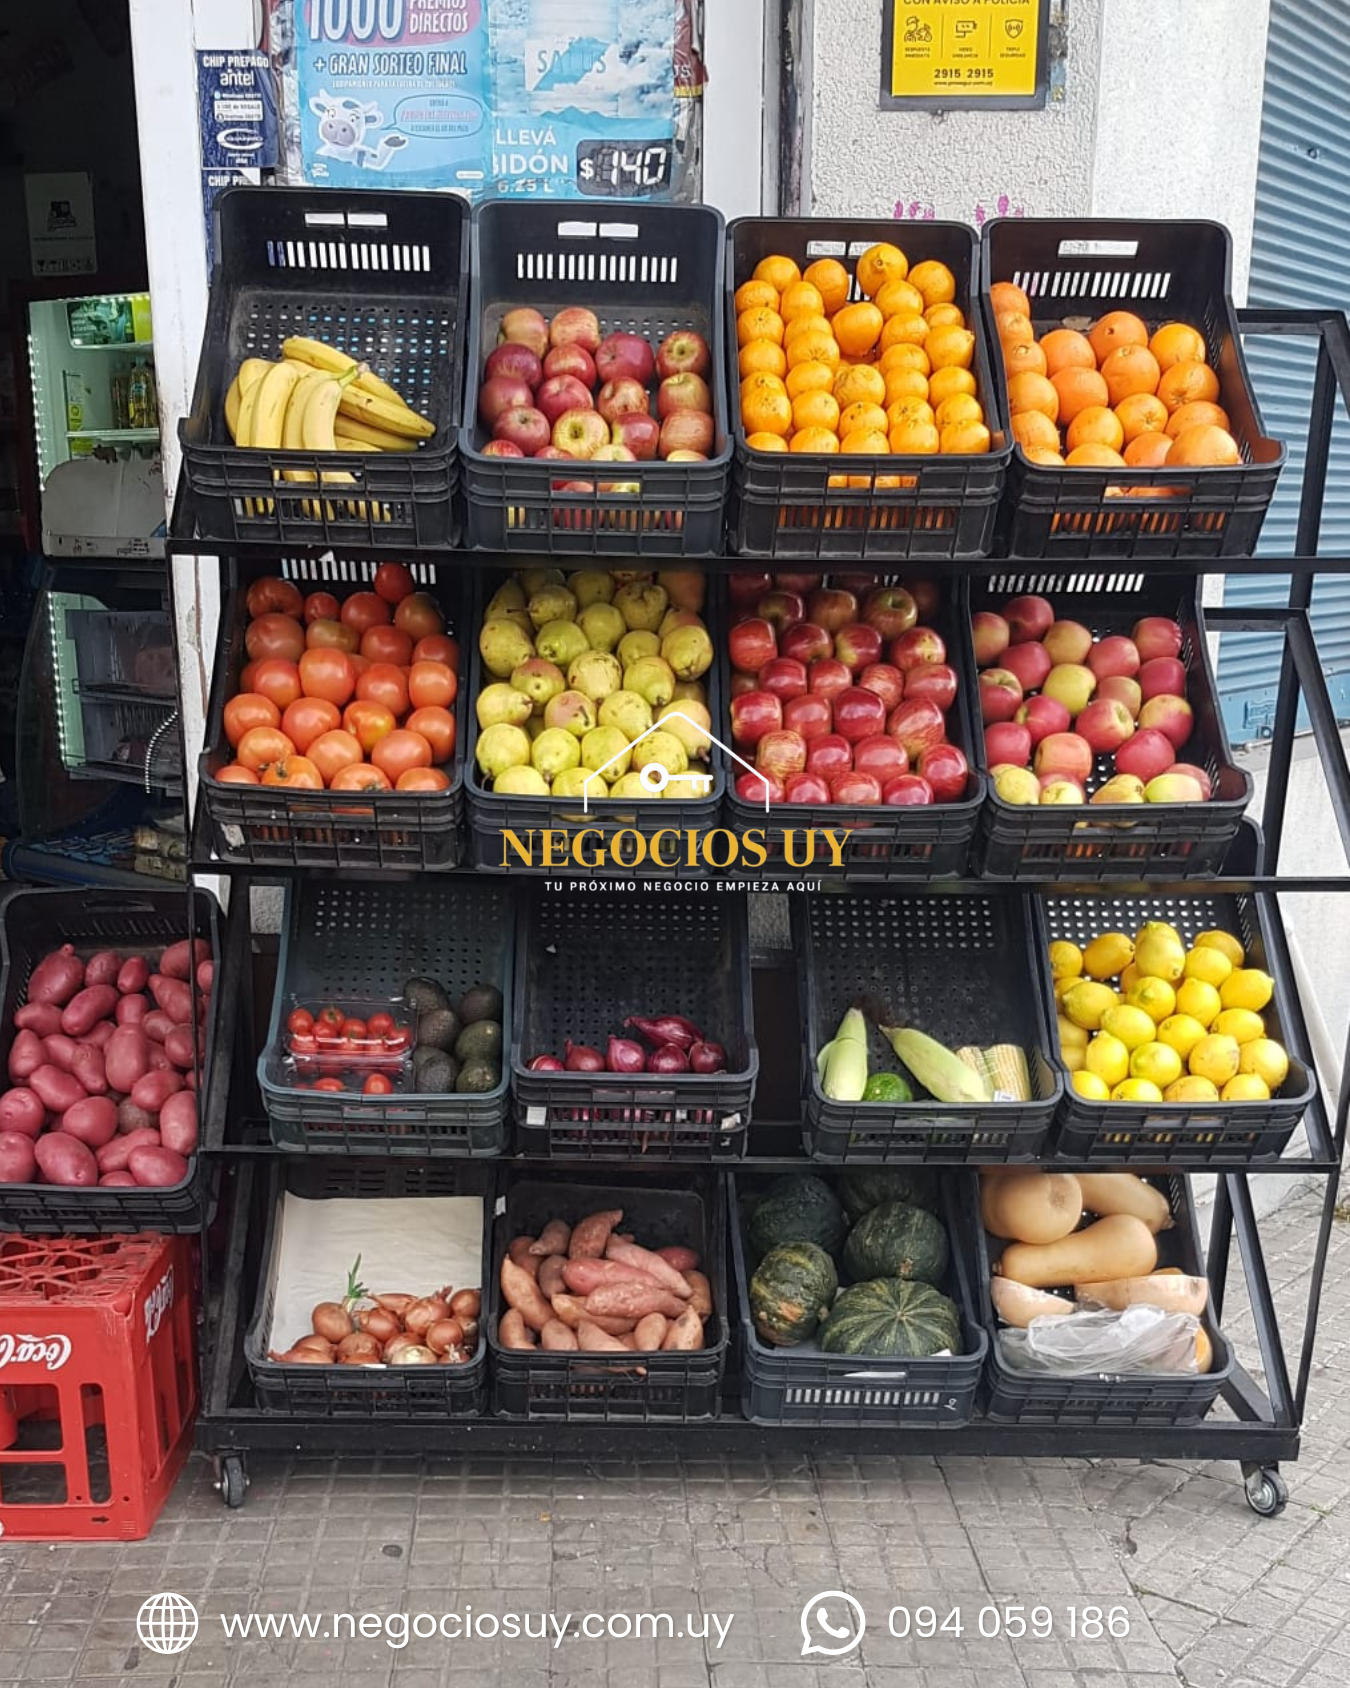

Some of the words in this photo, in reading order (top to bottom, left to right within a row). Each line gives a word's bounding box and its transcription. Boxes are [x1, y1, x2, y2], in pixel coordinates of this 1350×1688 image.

[409, 13, 468, 33] DIRECTOS
[202, 56, 226, 68] CHIP
[227, 56, 269, 68] PREPAGO
[329, 53, 370, 76] GRAN
[373, 52, 424, 75] SORTEO
[428, 51, 467, 75] FINAL
[220, 69, 255, 86] antel
[934, 69, 961, 79] 2915
[967, 69, 994, 79] 2915
[496, 127, 557, 145] LLEVÁ
[208, 175, 230, 187] CHIP
